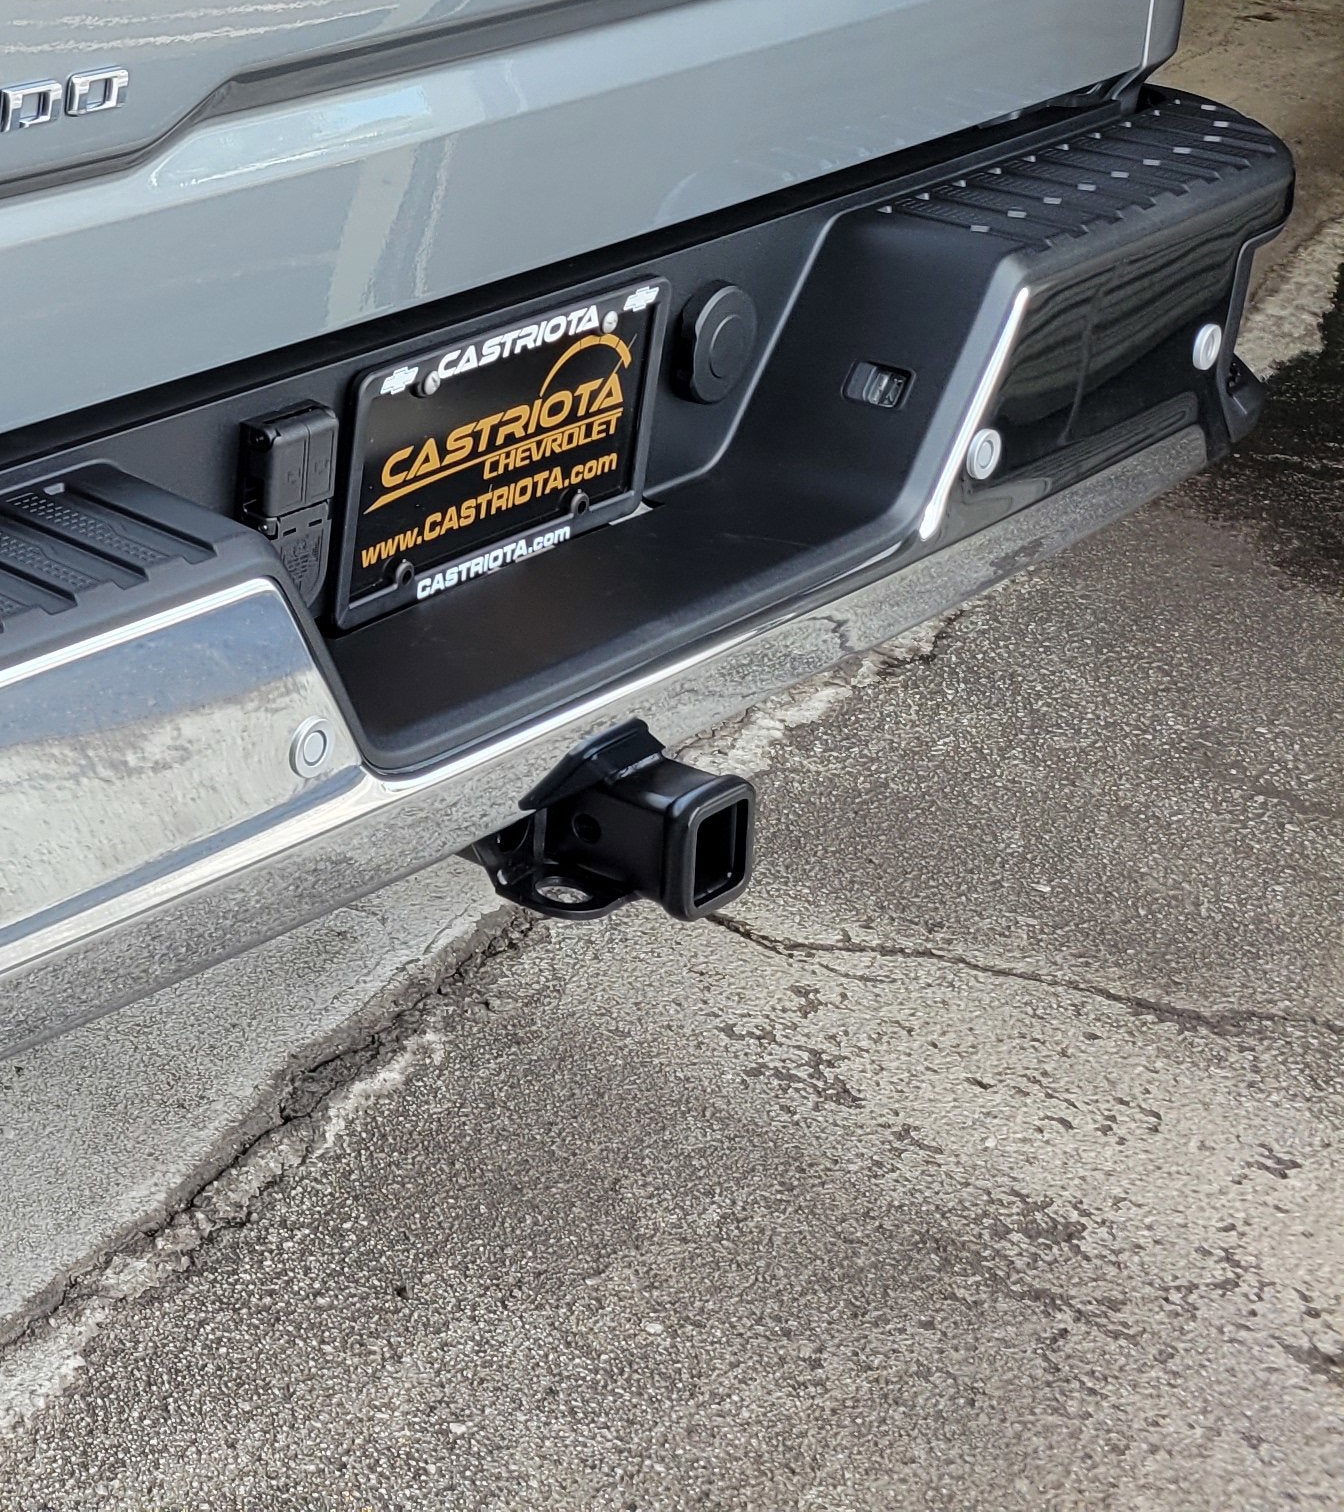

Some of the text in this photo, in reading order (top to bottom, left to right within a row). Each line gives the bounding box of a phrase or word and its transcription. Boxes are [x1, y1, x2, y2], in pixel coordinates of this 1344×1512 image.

[437, 304, 601, 380] CASTRIOTA
[381, 373, 624, 488] CASTRIOTA
[482, 411, 623, 481] CHEVROLET
[360, 452, 618, 569] www.CASTRIOTA.com
[416, 525, 571, 601] CASTRIOTA.com
